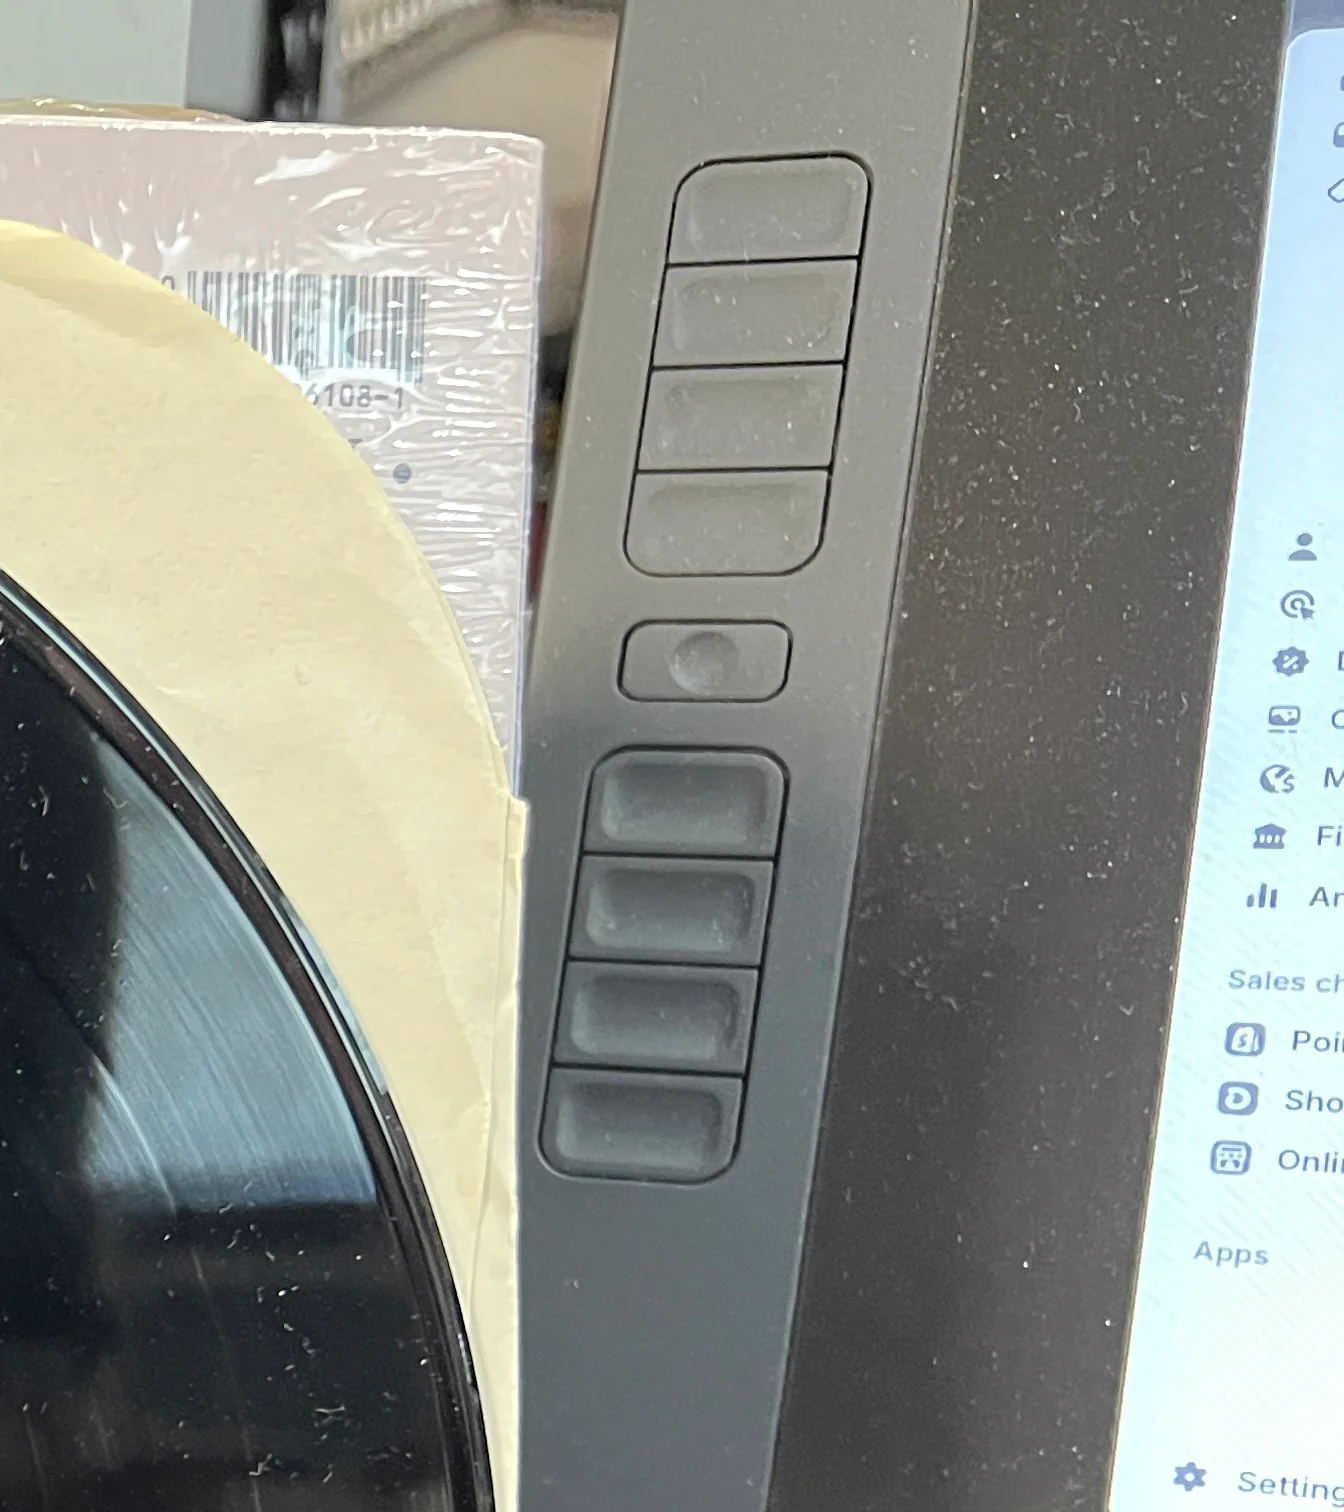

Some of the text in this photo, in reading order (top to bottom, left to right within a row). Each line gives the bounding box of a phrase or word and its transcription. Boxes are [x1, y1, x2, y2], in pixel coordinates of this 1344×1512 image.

[1228, 969, 1305, 992] Sales
[1292, 1030, 1344, 1053] Poi
[1285, 1089, 1344, 1113] Sho
[1278, 1148, 1344, 1174] Onli
[1193, 1240, 1269, 1268] Apps
